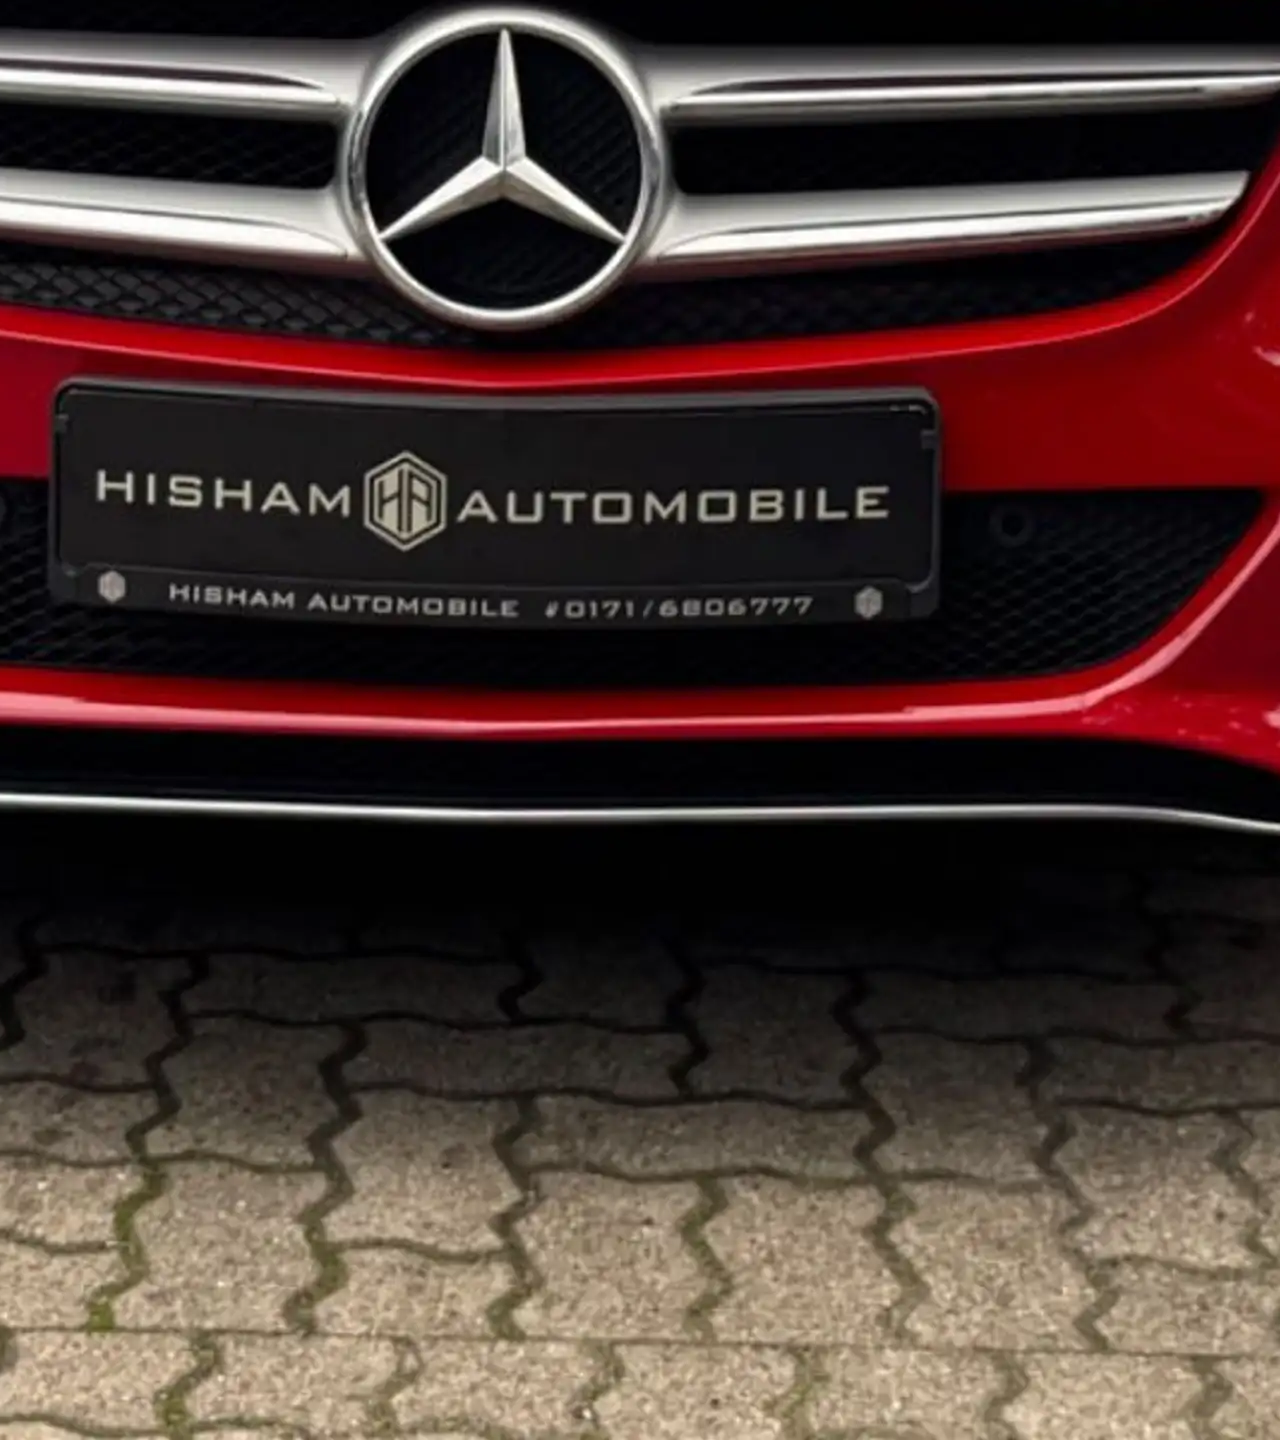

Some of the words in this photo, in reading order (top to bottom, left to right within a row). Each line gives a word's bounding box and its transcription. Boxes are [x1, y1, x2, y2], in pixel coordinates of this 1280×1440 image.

[95, 468, 352, 518] HISHAM
[456, 485, 890, 524] AUTOMOBILE
[169, 582, 295, 610] HISHAM
[306, 592, 519, 619] AUTOMOBILE
